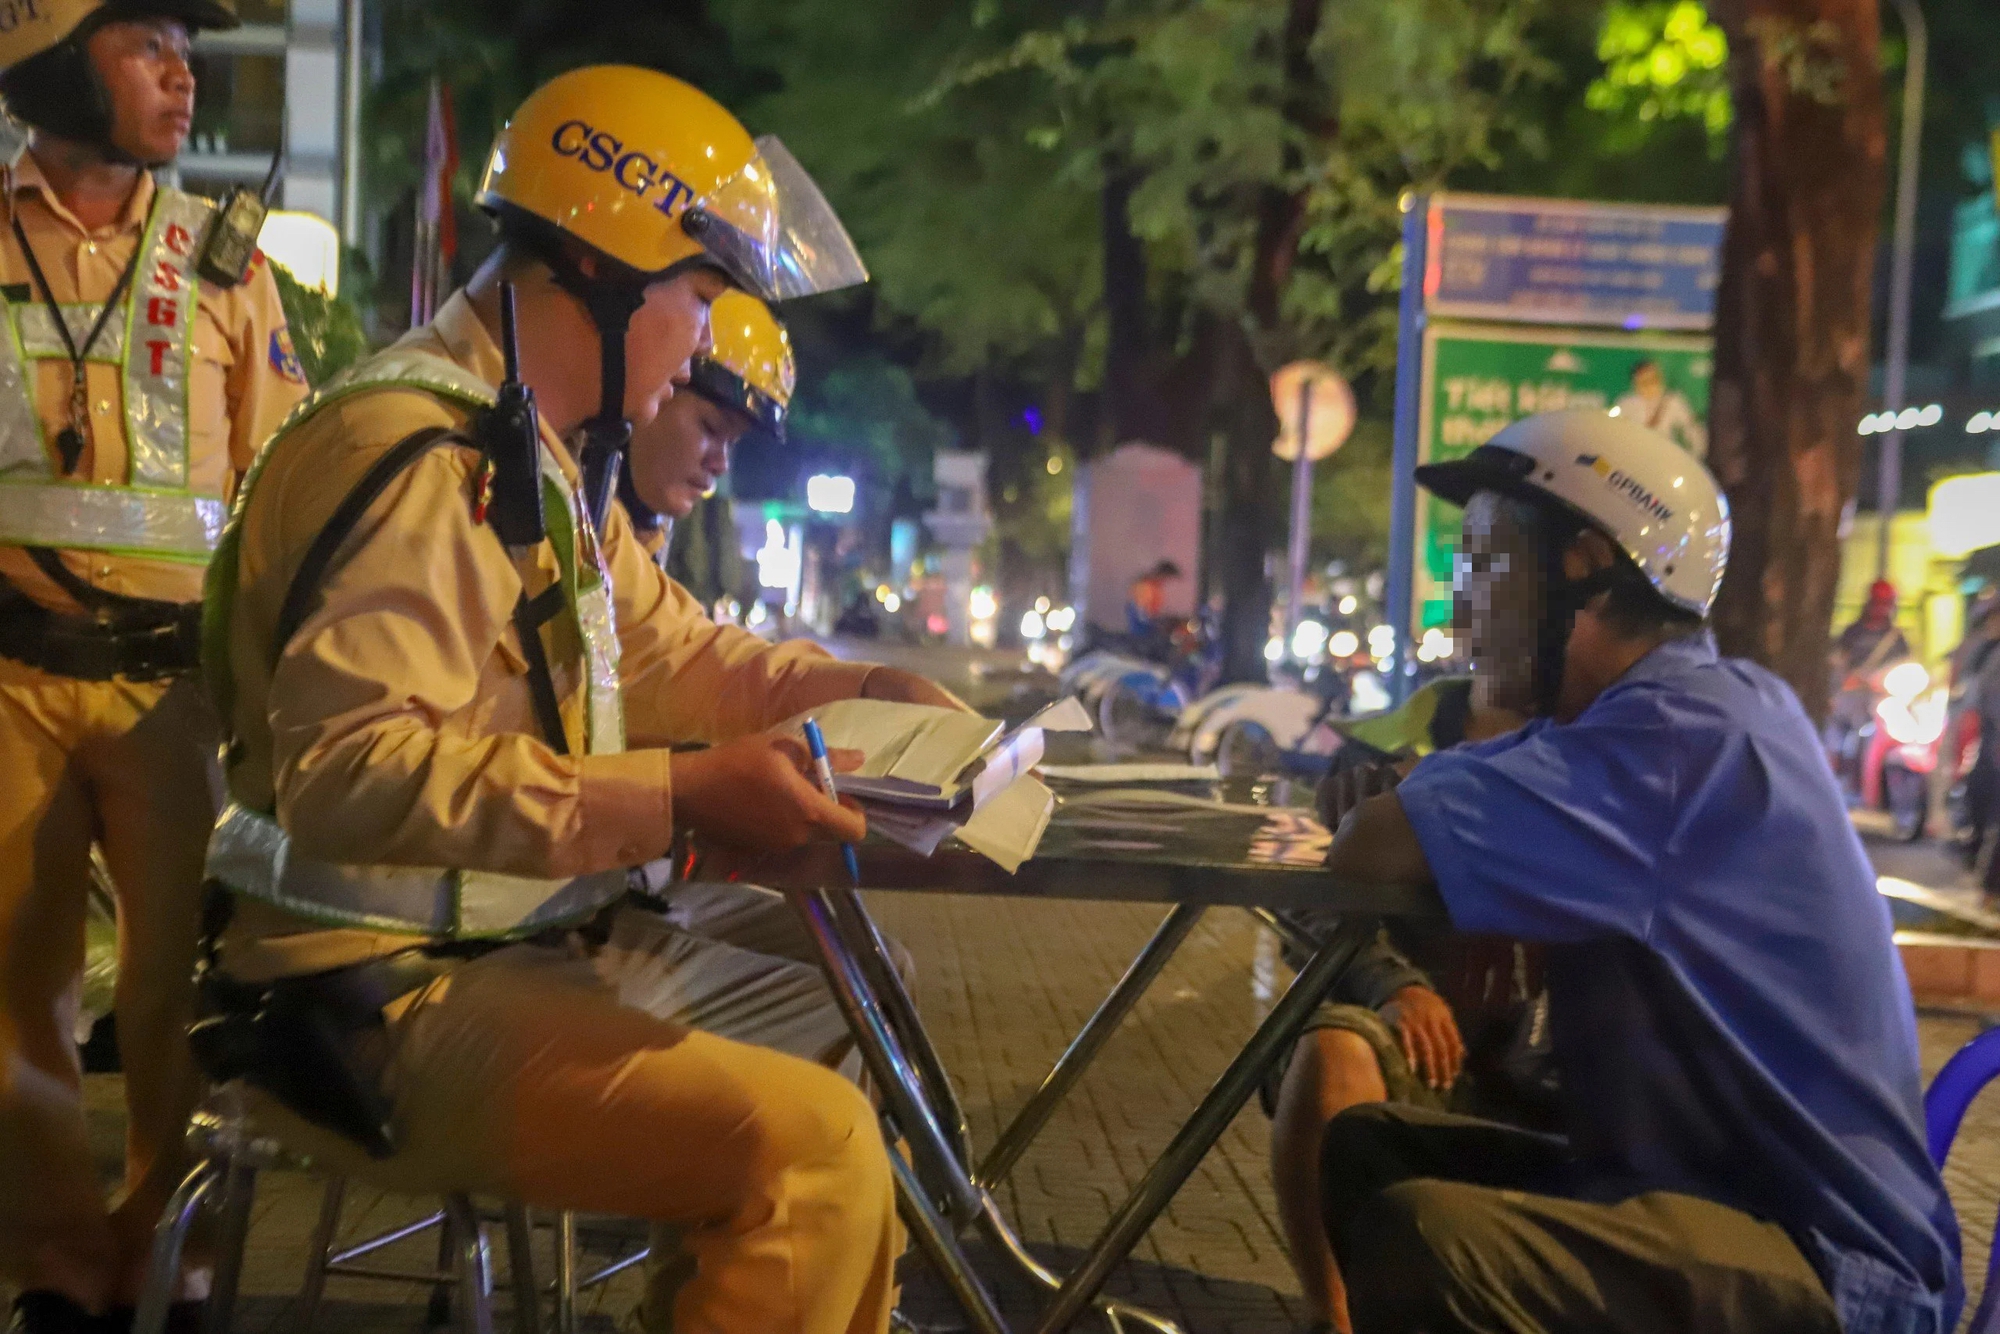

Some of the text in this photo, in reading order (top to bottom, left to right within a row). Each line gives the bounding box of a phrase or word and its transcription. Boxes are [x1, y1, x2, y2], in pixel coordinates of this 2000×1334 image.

[552, 119, 694, 218] CSGT
[145, 222, 190, 376] CSGT
[1608, 470, 1673, 520] GPBANK
